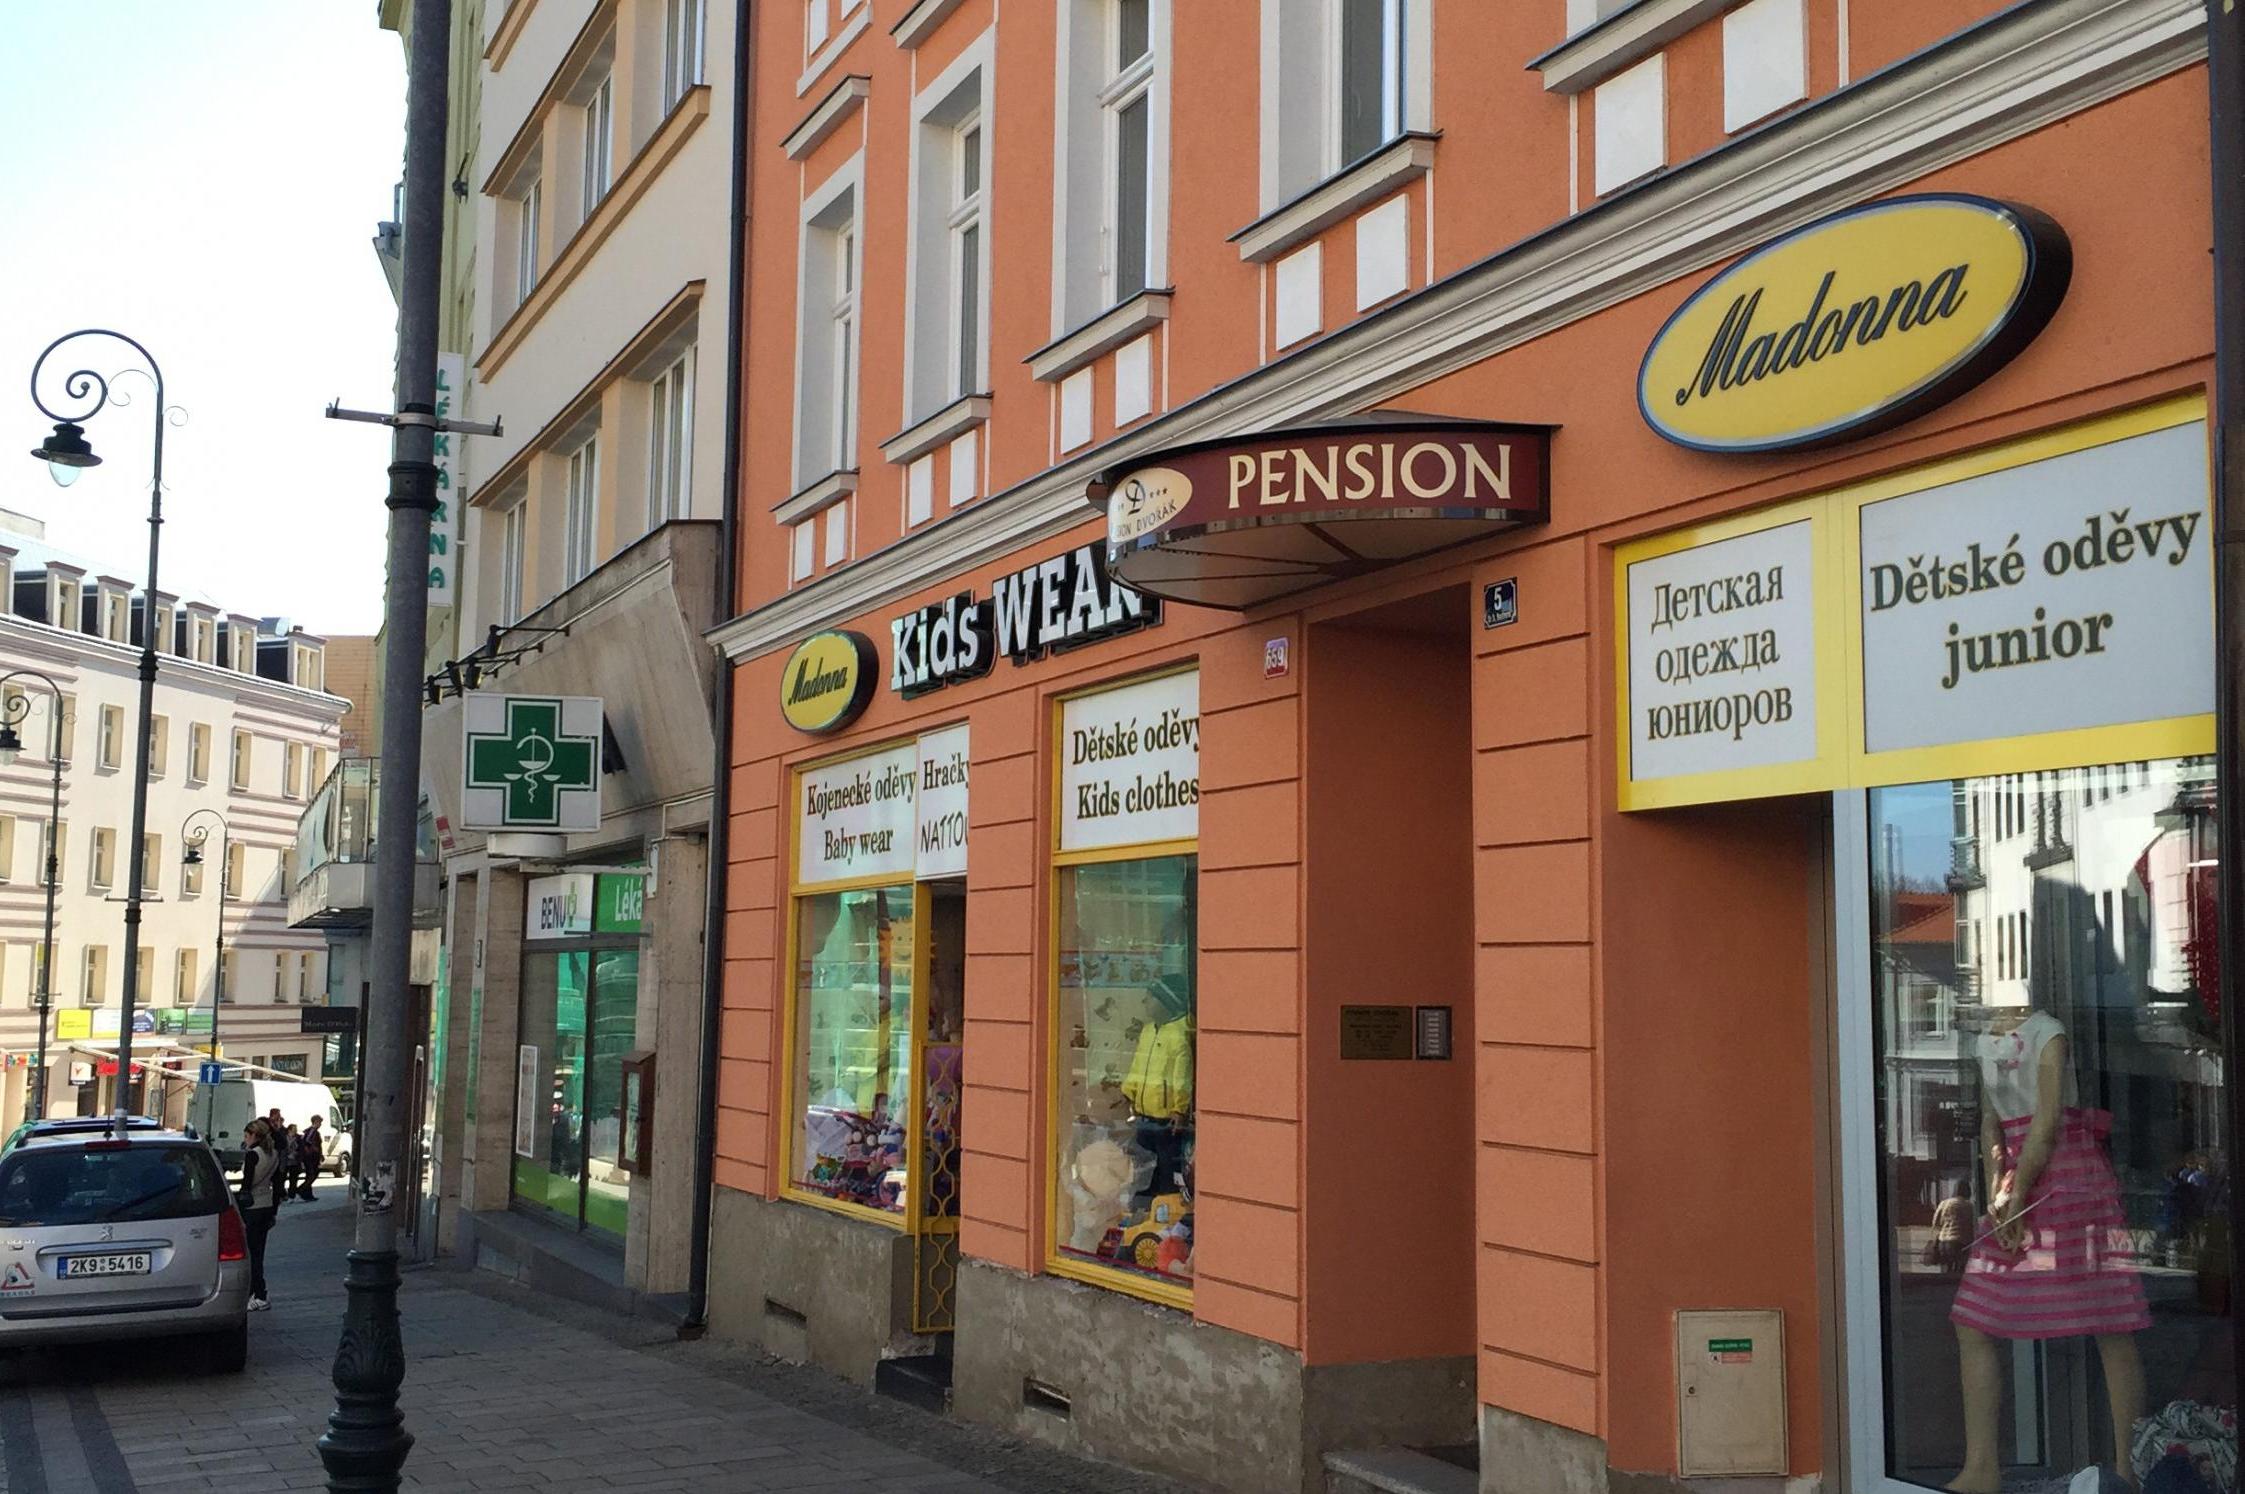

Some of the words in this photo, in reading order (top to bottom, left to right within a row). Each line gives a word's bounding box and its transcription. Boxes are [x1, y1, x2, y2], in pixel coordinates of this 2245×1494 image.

[1675, 263, 1969, 406] Madonna
[429, 368, 450, 589] LÉKÁRNA
[1228, 442, 1511, 509] PENSION
[1870, 532, 2025, 613] Dětské
[2043, 507, 2202, 577] oděvy
[1493, 586, 1503, 611] 5
[1651, 565, 1784, 635] Детская
[890, 596, 980, 691] Kids
[1265, 646, 1285, 670] 659
[1655, 628, 1781, 686] одежда
[1941, 606, 2114, 690] junior
[786, 656, 849, 707] Madonna
[1072, 717, 1139, 766] Dětské
[1647, 687, 1793, 742] юниоров
[807, 769, 872, 821] Kojenecké
[874, 763, 917, 804] oděvy
[1077, 779, 1121, 820] Kids
[1125, 769, 1200, 814] clothes
[823, 827, 857, 866] Baby
[859, 828, 894, 856] wear
[540, 895, 567, 930] BENU
[70, 1258, 98, 1274] 2K9
[108, 1255, 144, 1271] 5416
